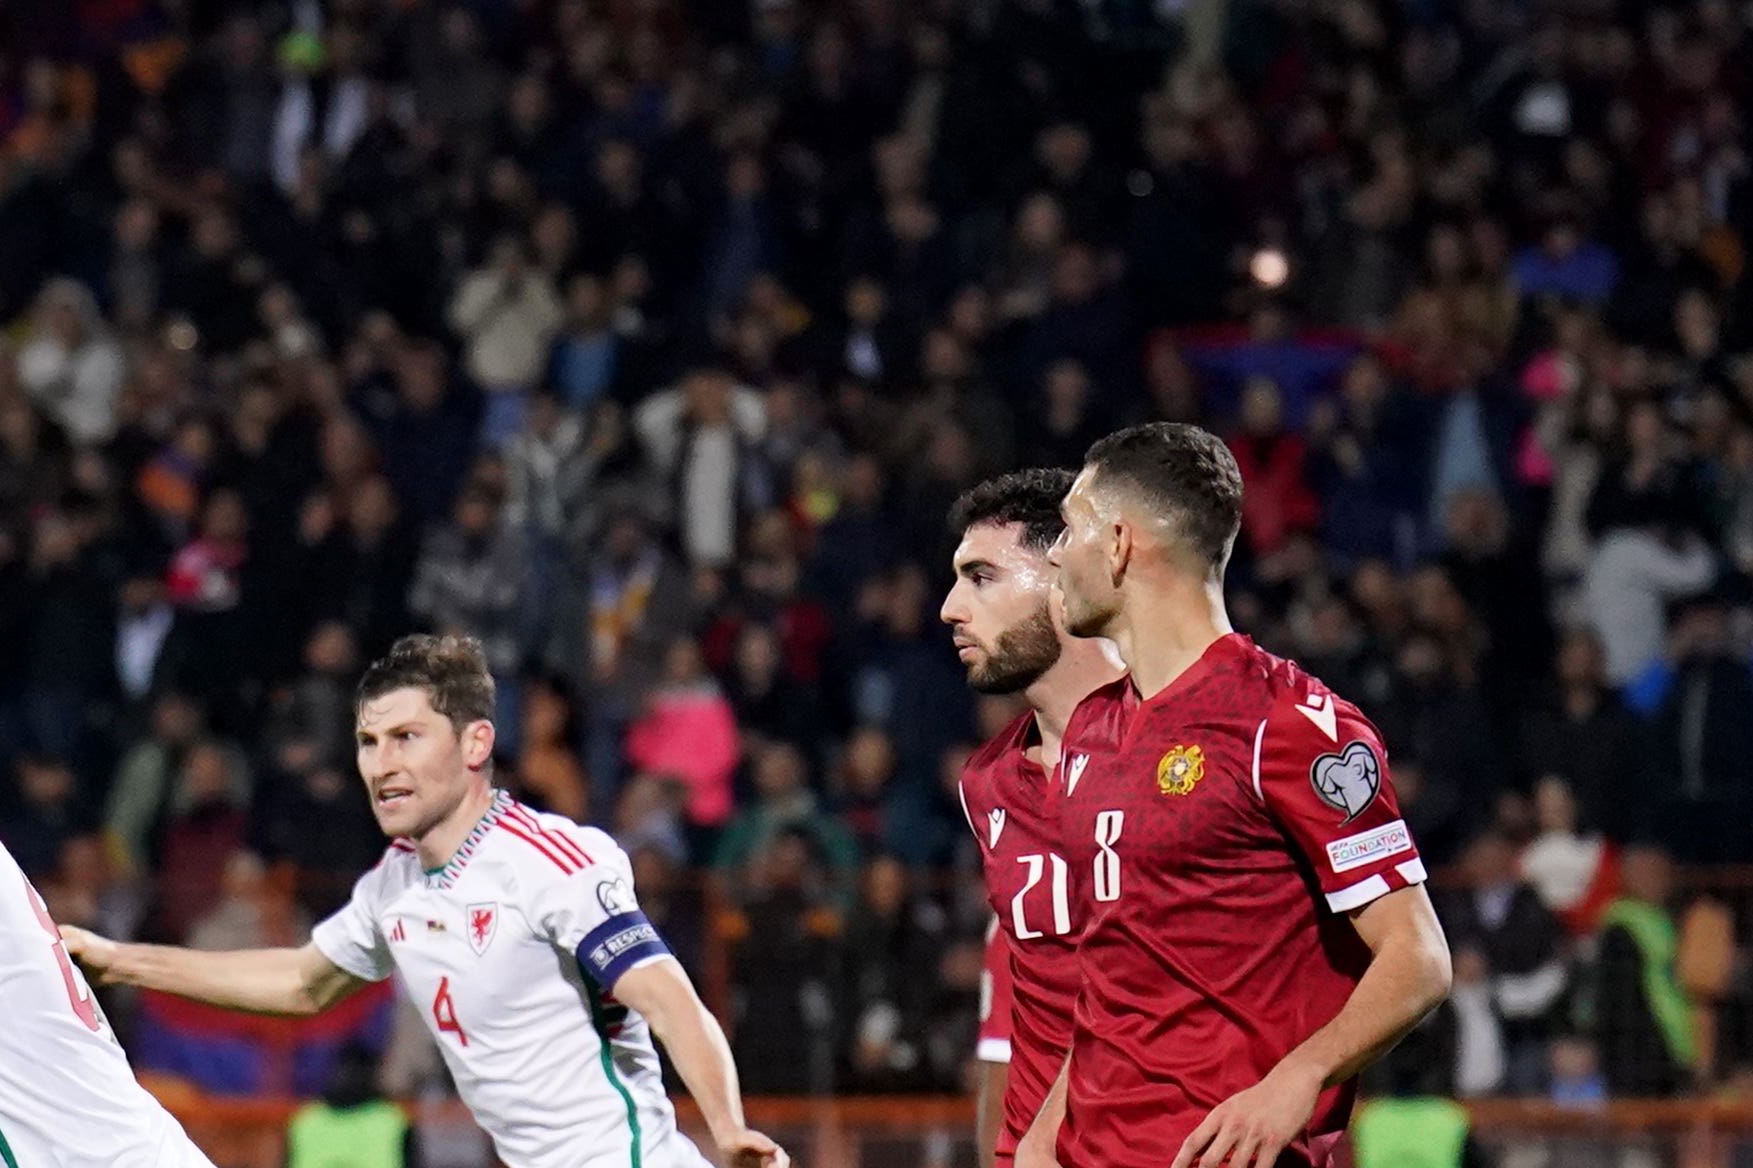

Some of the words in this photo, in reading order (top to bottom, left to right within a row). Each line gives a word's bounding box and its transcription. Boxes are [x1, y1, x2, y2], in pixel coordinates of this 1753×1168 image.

[1093, 810, 1125, 902] 8
[1332, 830, 1407, 862] FOUNDATION
[1011, 852, 1071, 940] 21
[607, 926, 656, 954] RESPEC
[433, 976, 468, 1048] 4
